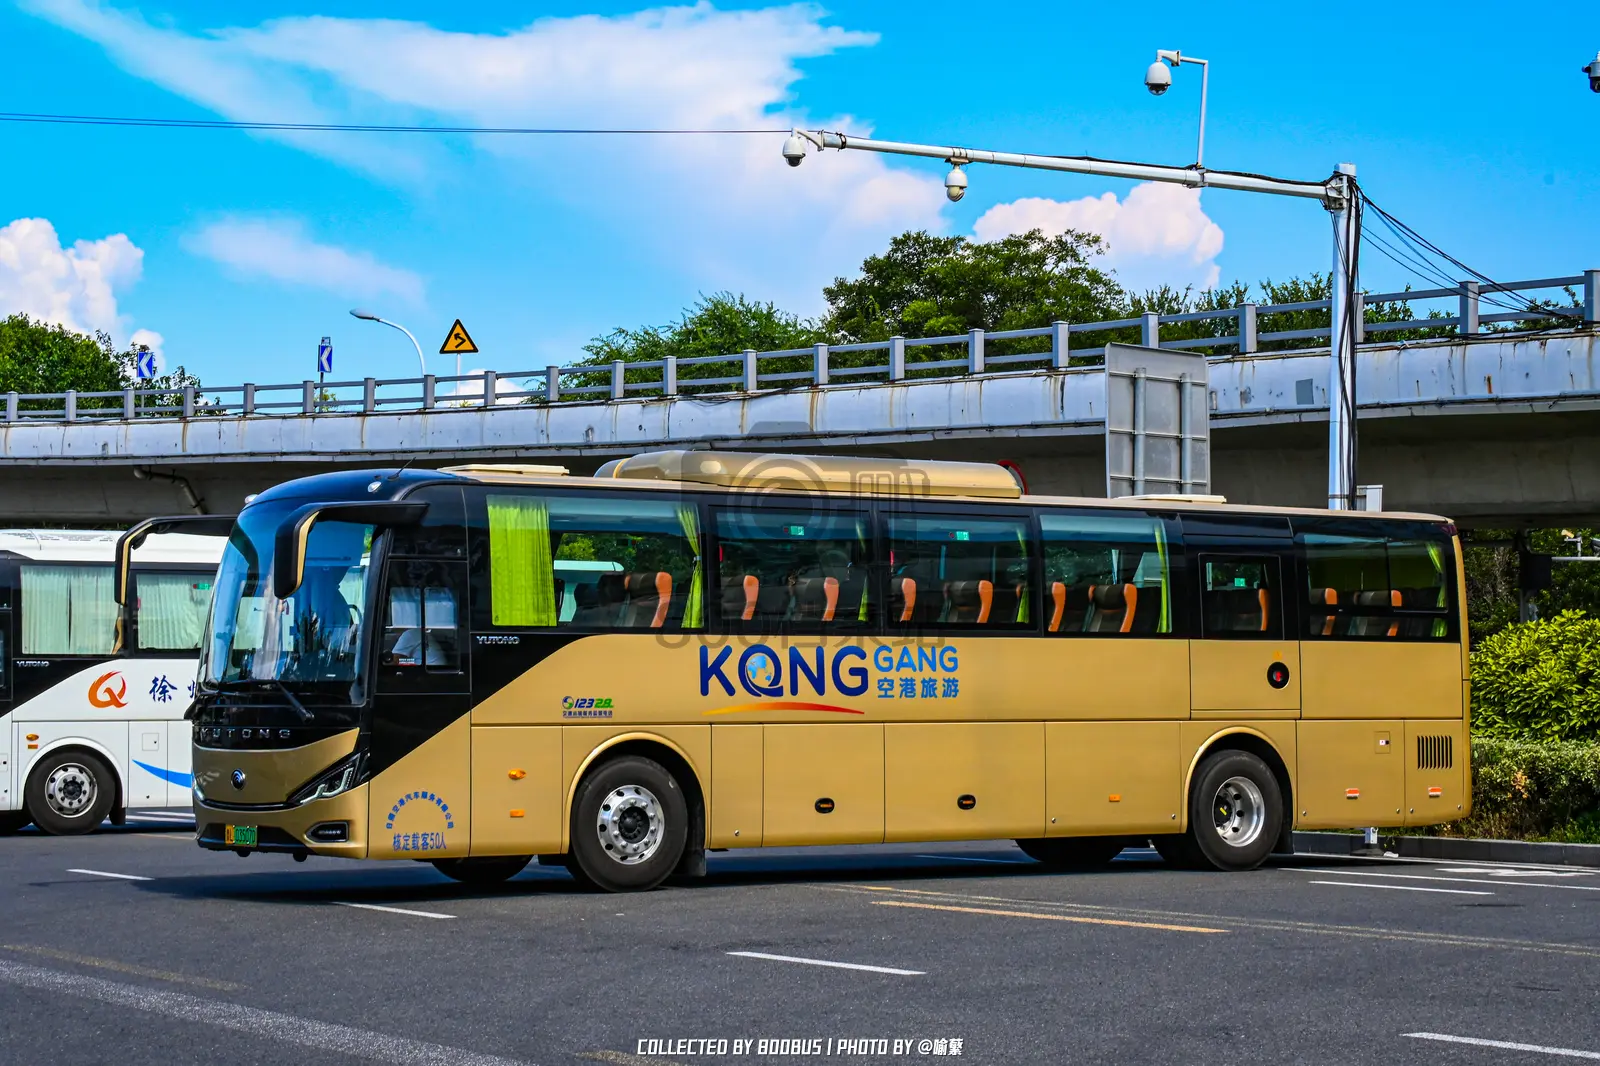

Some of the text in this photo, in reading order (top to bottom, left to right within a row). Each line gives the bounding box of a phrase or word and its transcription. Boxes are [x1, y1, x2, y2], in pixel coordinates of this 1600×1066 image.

[476, 635, 520, 645] YUTONG
[16, 660, 50, 668] YUTONG
[873, 645, 959, 672] GANG
[699, 643, 869, 697] KONG
[877, 677, 960, 698] 空港旅游
[574, 698, 614, 709] 12328
[200, 728, 291, 739] YUTONG
[392, 832, 447, 851] 核定载客50人
